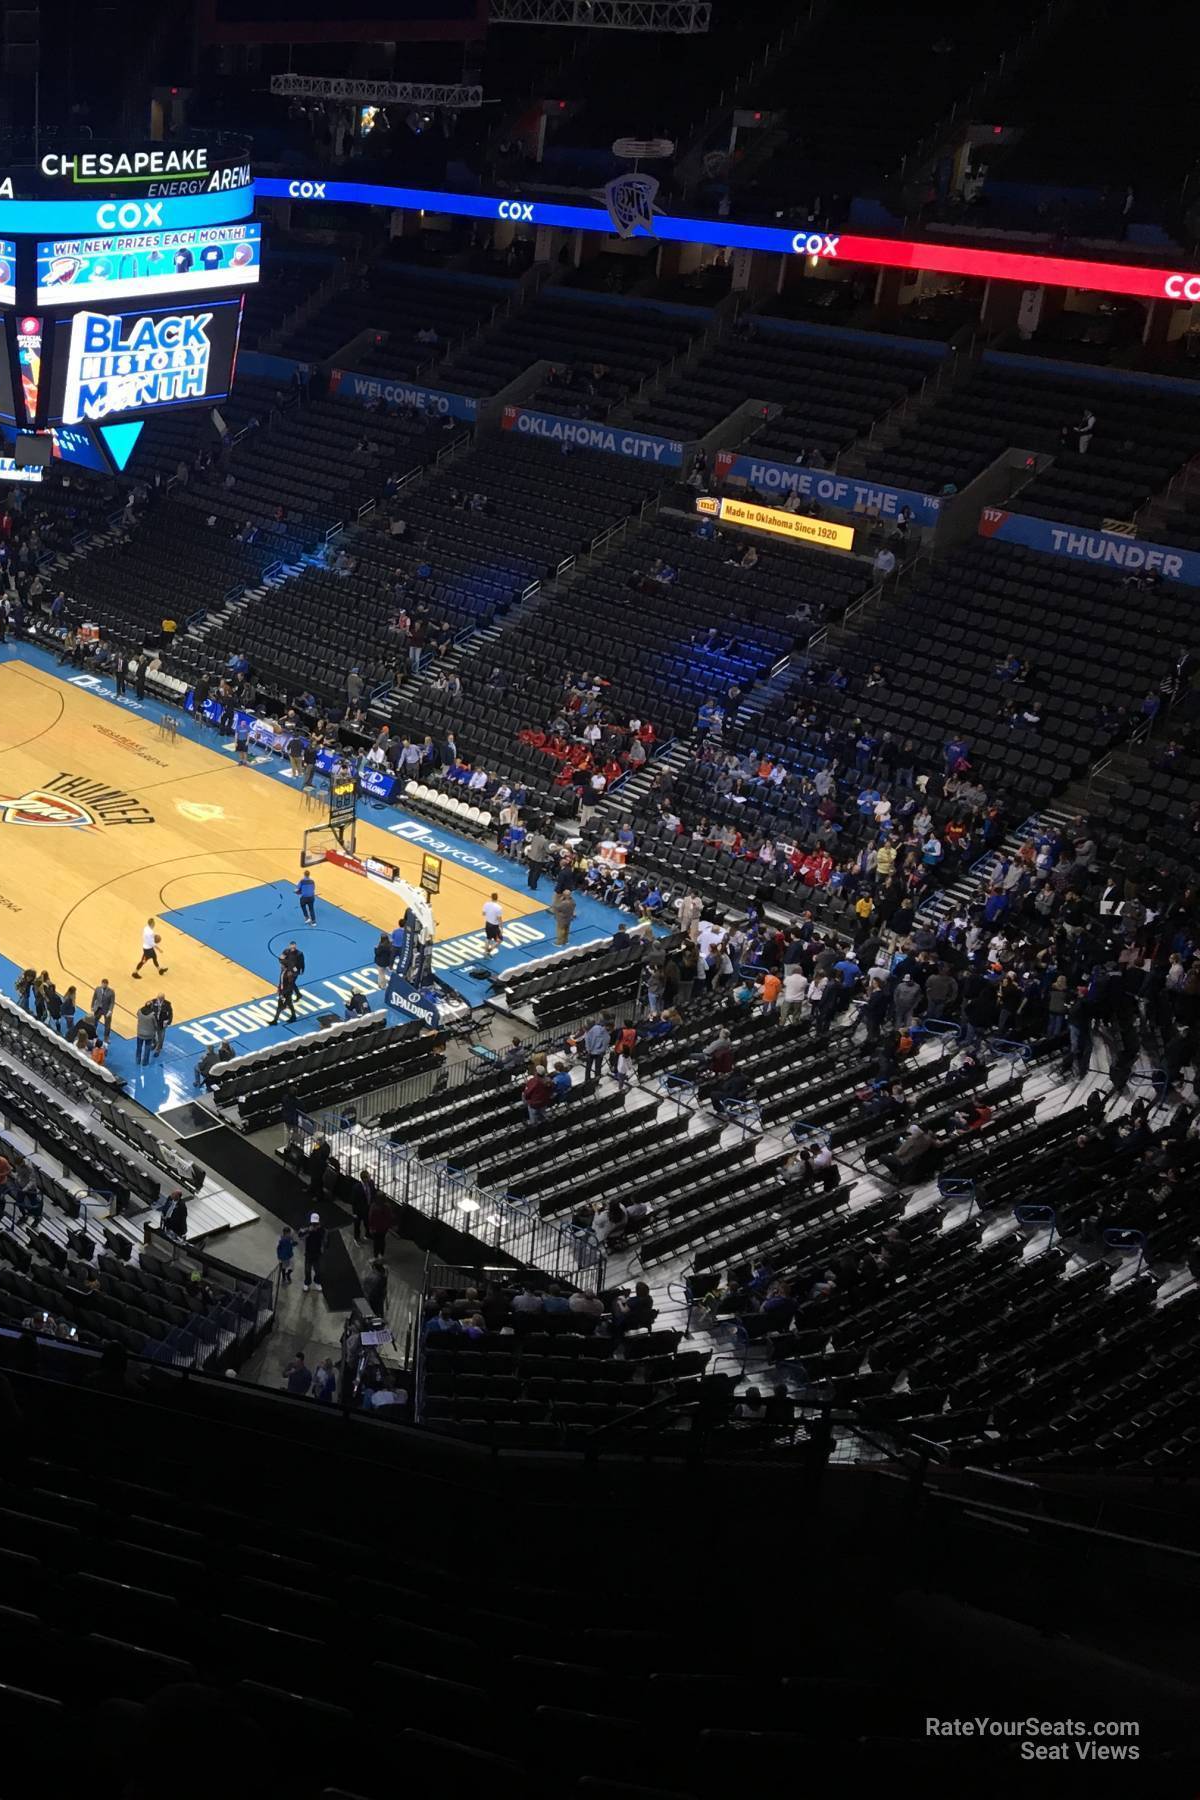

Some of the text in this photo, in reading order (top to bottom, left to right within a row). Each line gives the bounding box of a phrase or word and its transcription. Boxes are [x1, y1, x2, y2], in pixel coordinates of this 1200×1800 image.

[41, 148, 208, 176] CHESAPEAKE
[148, 164, 251, 197] ENERGY ARENA
[289, 181, 326, 198] COX
[96, 202, 163, 229] COX
[498, 201, 535, 221] COX
[54, 227, 247, 255] WIN NEW PRIZES EACH MONTH!
[792, 233, 840, 256] COX
[84, 315, 208, 353] BLACK
[80, 348, 208, 381] HISTORY
[76, 366, 205, 419] MNTH
[353, 379, 449, 413] WELCOME TO
[517, 415, 665, 461] OKLAHOMA CITY
[750, 464, 899, 514] HOME OF THE
[725, 505, 745, 518] Made
[756, 513, 793, 530] Oklahoma
[795, 521, 816, 535] Since
[818, 527, 838, 541] 1920
[984, 509, 1003, 523] 117
[1051, 529, 1184, 578] THUNDER
[41, 771, 156, 826] THUNDER
[416, 833, 502, 875] paycom
[390, 991, 434, 1026] SPALDING
